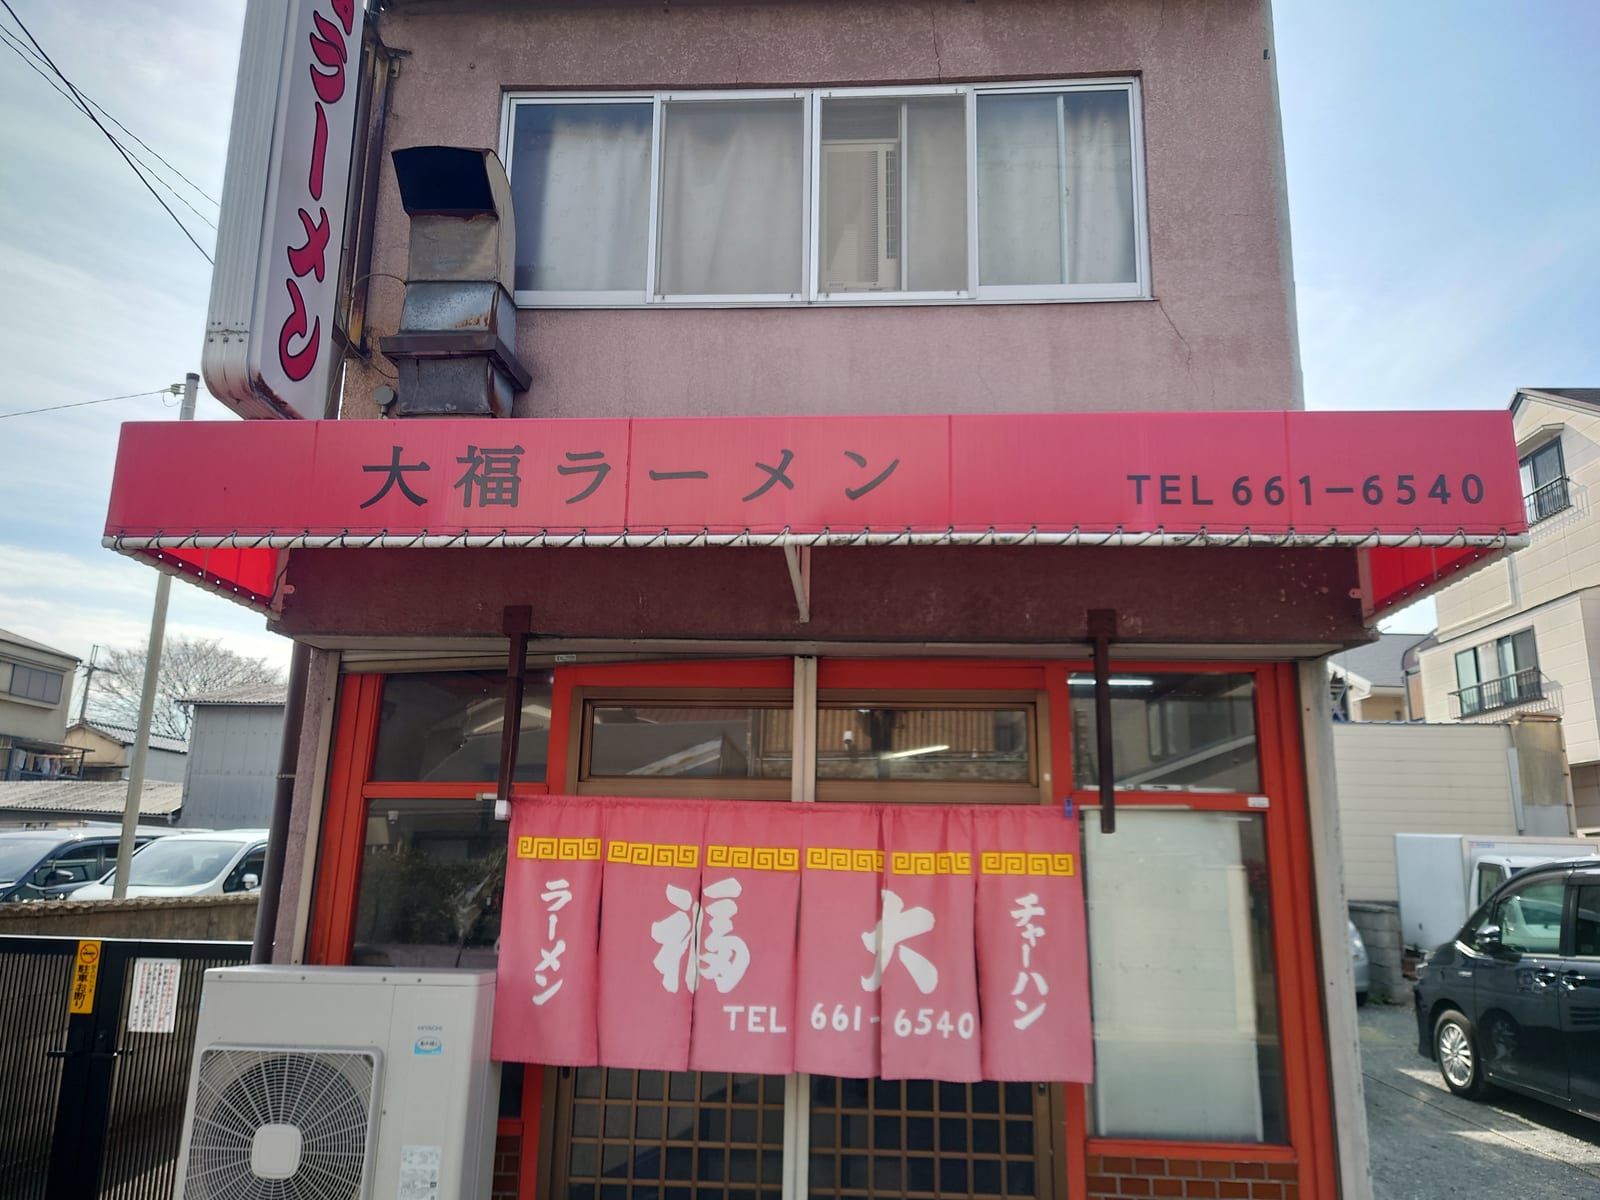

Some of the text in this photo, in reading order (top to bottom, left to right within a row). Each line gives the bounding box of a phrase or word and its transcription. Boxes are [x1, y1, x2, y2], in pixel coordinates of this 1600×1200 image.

[278, 0, 355, 382] ラーメン
[359, 444, 900, 509] 大福ラーメン
[1126, 474, 1214, 506] TEL
[531, 878, 573, 1007] ラーメン
[1009, 892, 1049, 1032] チャーハン
[723, 1006, 787, 1033] TEL
